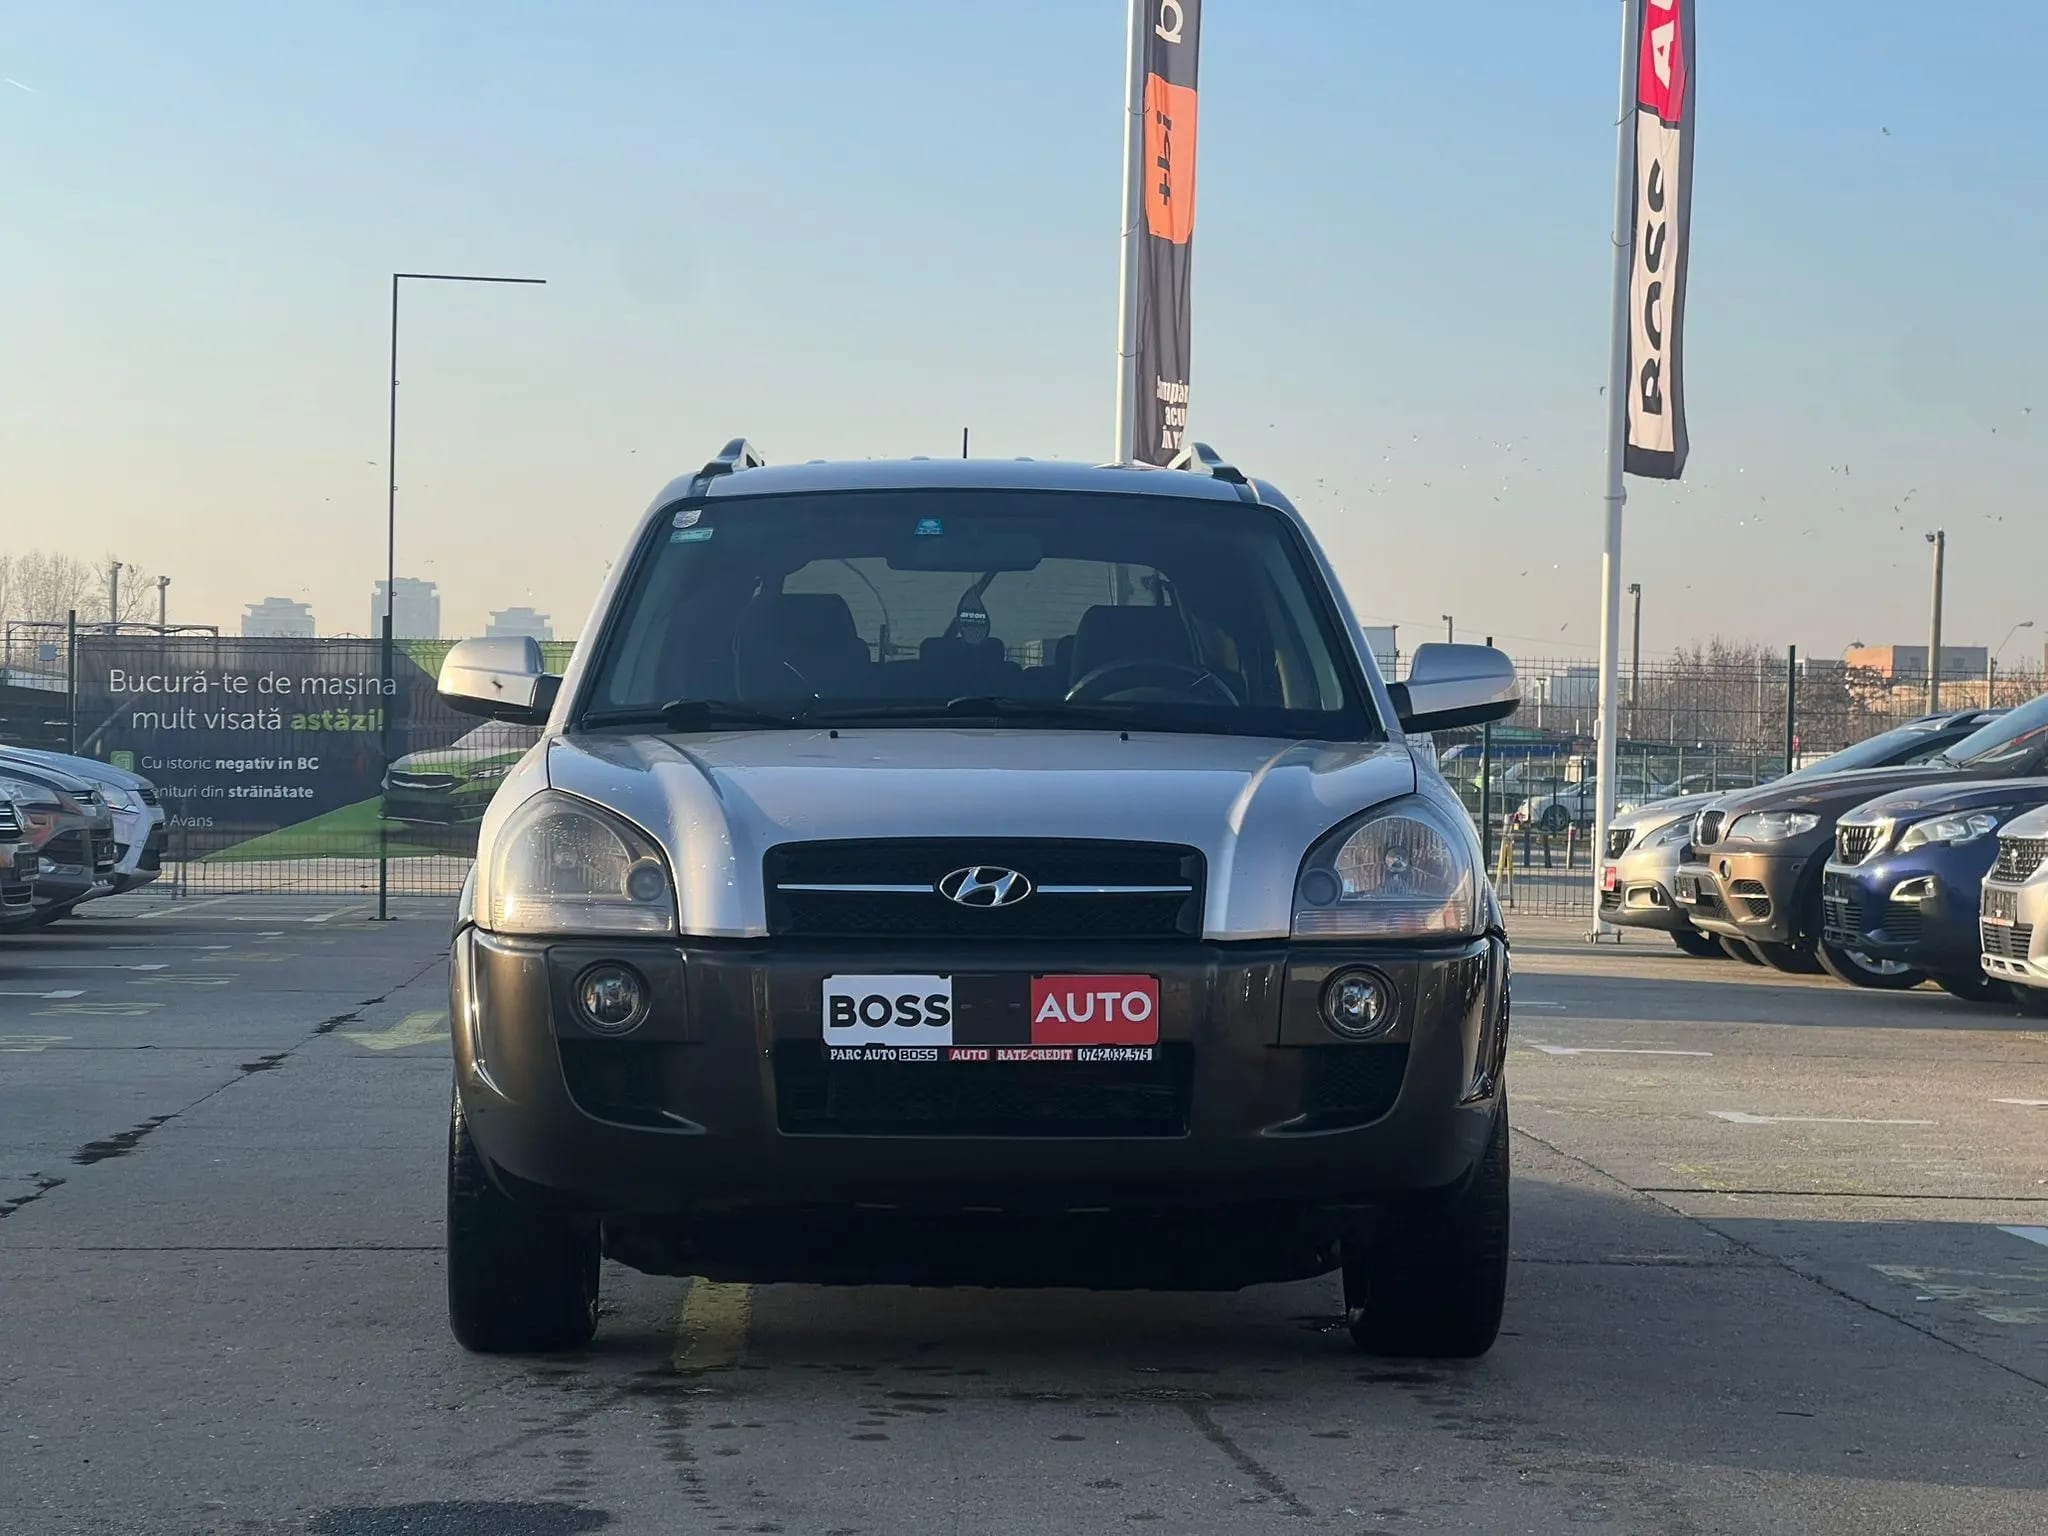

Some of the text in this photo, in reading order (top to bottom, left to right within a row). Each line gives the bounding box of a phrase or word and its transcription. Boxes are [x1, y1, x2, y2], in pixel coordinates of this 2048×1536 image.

[110, 669, 397, 701] Bucură-te de mașina
[132, 706, 384, 731] mult visată astăzi!
[141, 756, 319, 772] Cu istoric negativ in BC
[151, 785, 314, 798] enituri din străinătate
[170, 814, 213, 827] Avans
[829, 991, 1152, 1028] BOSS AUTO
[830, 1049, 861, 1060] PARC
[864, 1049, 897, 1060] AUTO
[900, 1049, 937, 1061] BOSS
[951, 1050, 988, 1060] AUTO
